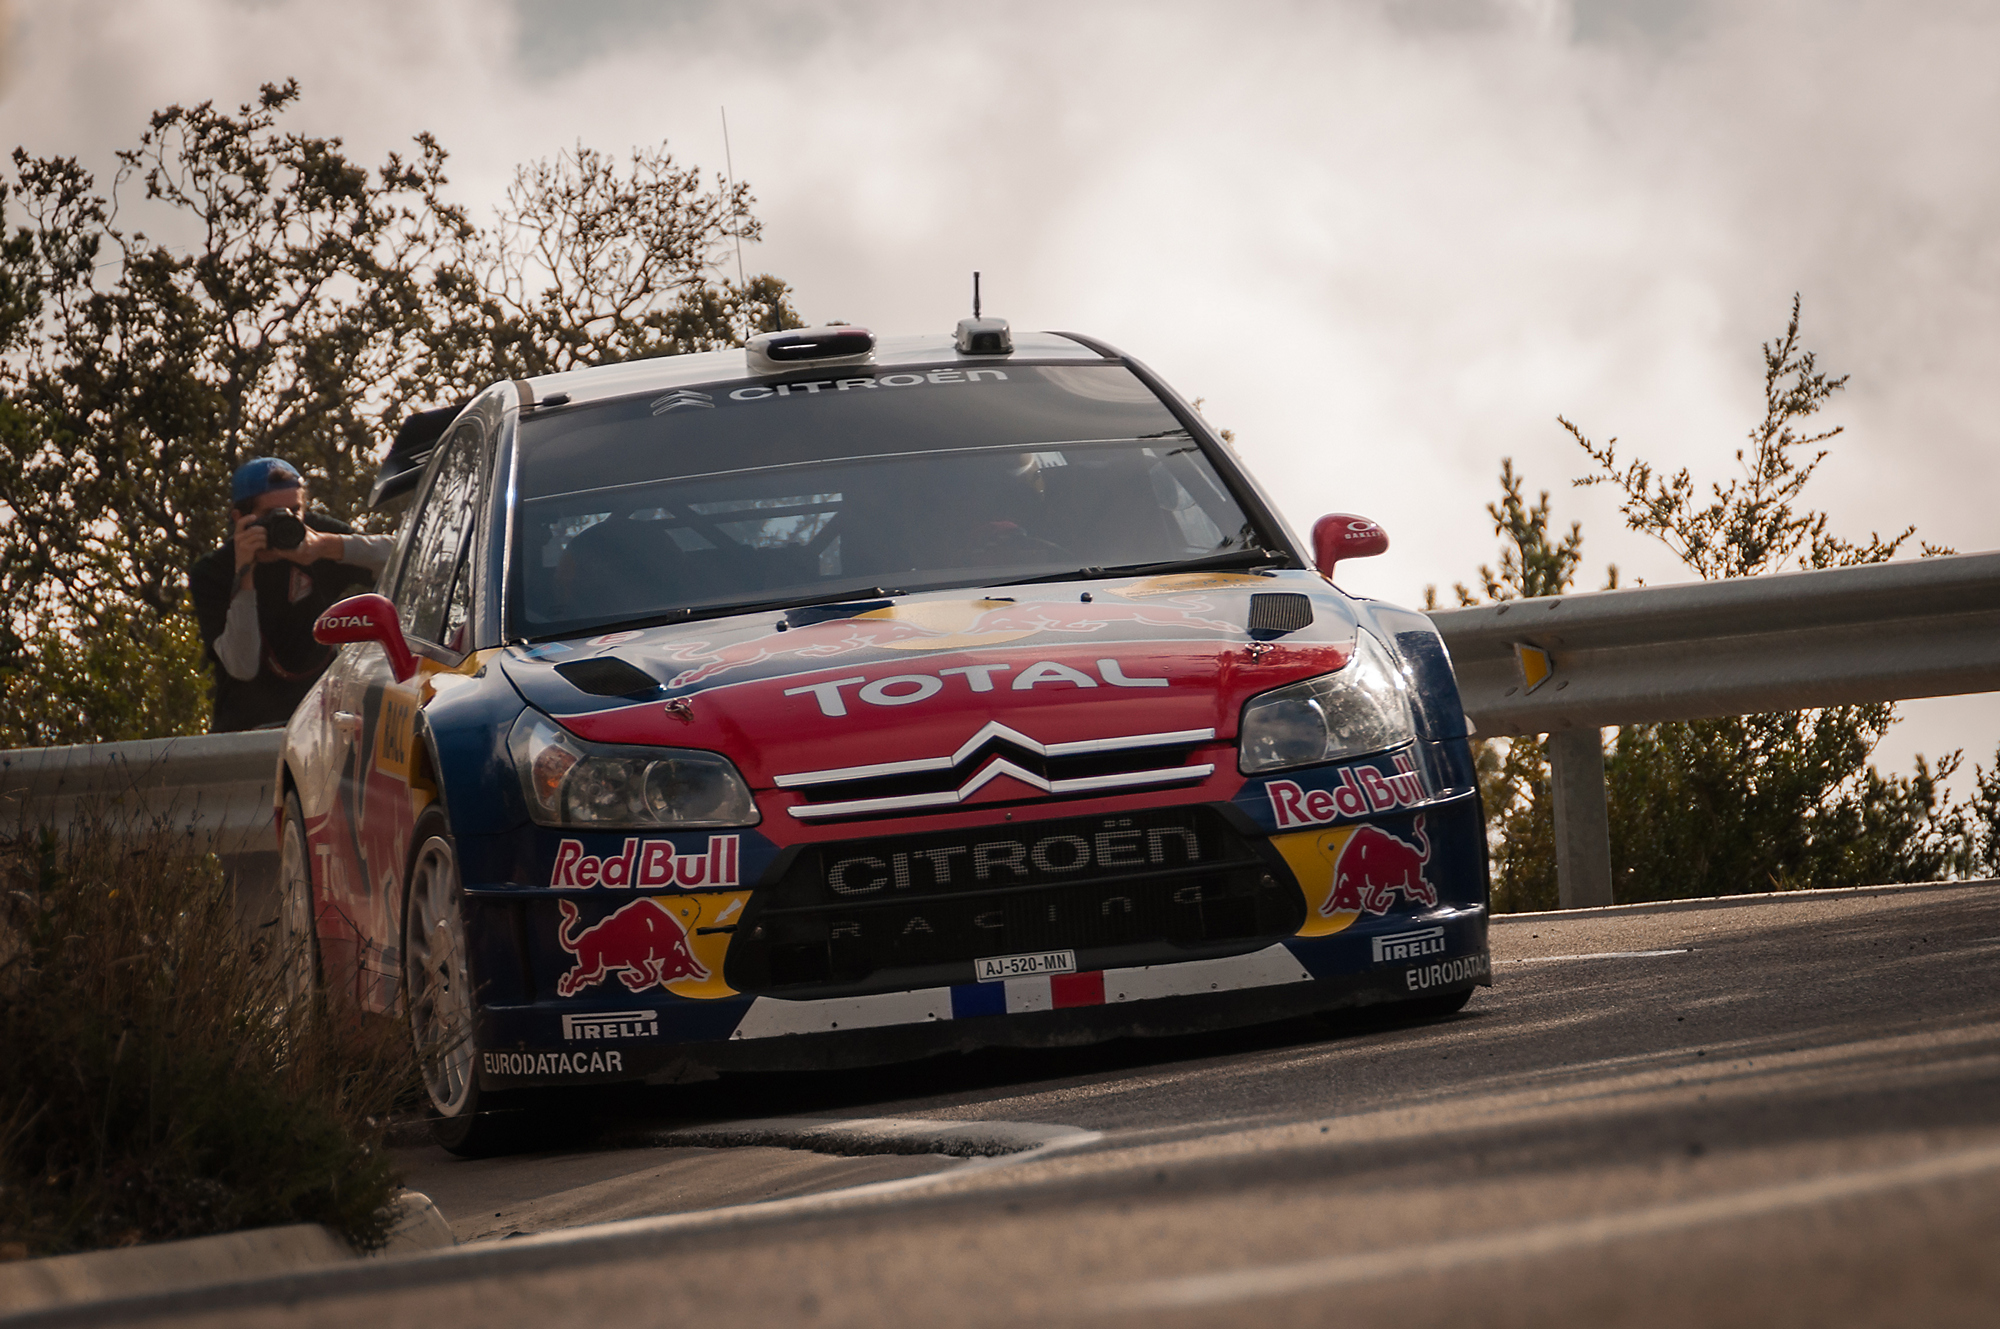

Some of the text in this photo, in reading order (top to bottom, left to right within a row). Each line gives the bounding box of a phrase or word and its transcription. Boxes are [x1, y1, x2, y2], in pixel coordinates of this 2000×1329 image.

[729, 368, 1009, 400] CITROËN
[320, 615, 374, 629] TOTAL
[783, 658, 1170, 717] TOTAL
[1265, 752, 1427, 829] Red Bull
[550, 834, 740, 889] Red Bull
[828, 818, 1200, 895] CITROËN
[1372, 925, 1446, 962] PIRELLI
[986, 953, 1068, 976] AJ-520-MN
[562, 1009, 659, 1040] PIRELLI
[484, 1050, 623, 1075] EURODATACAR
